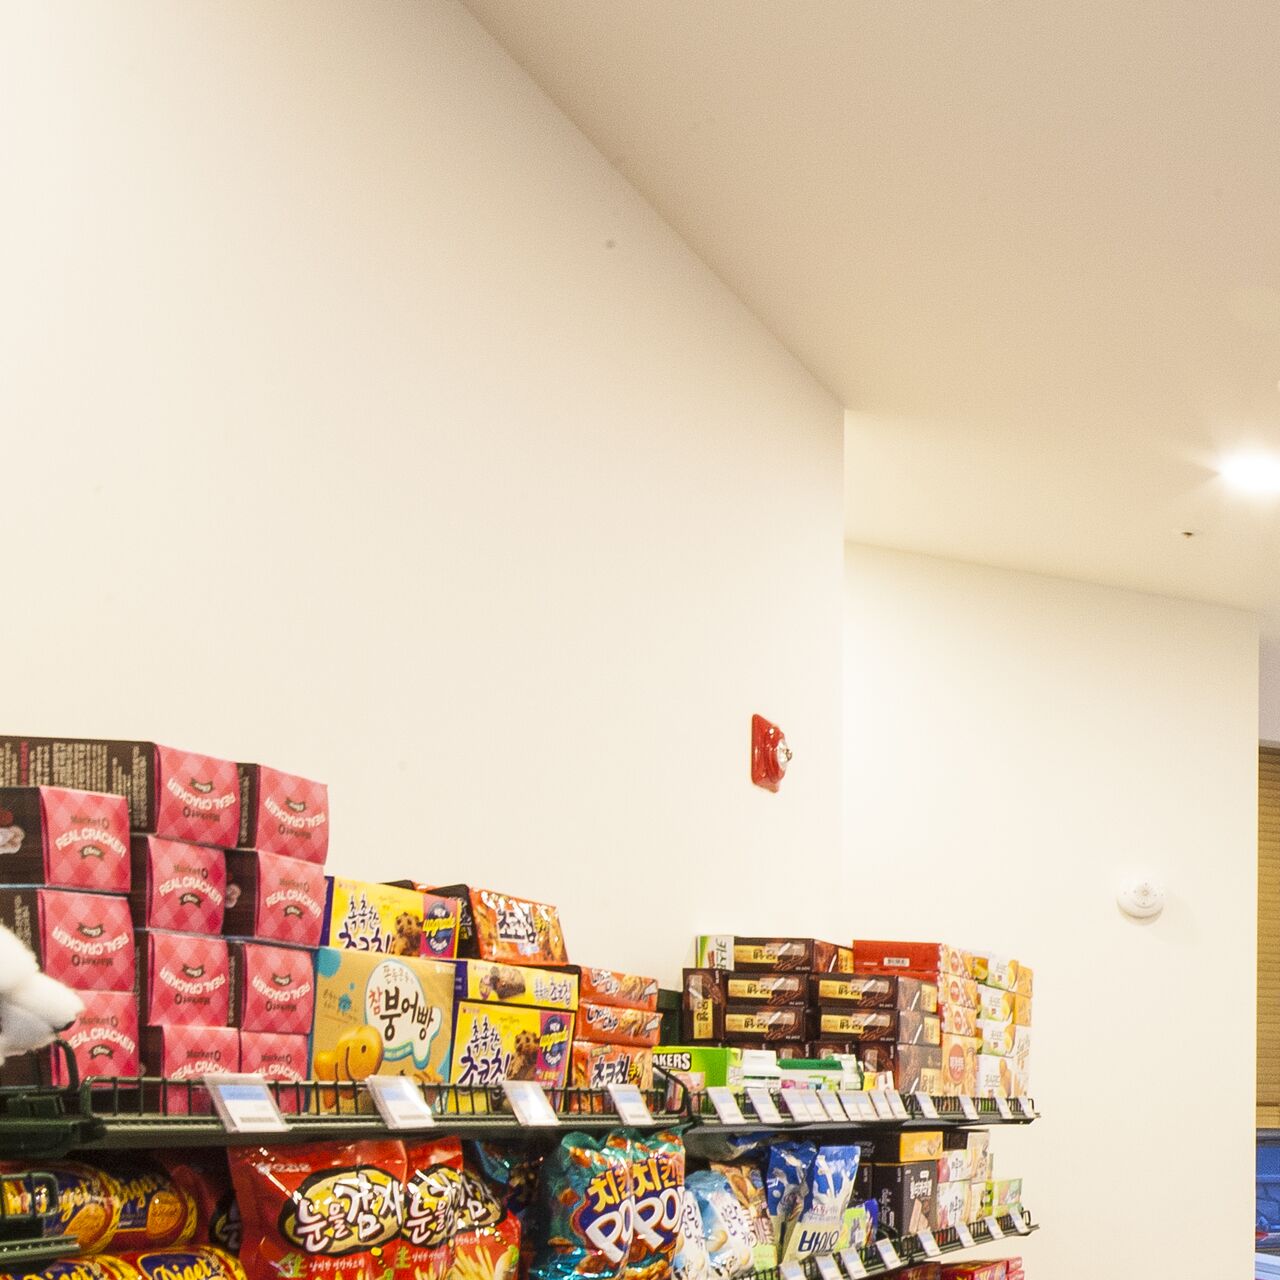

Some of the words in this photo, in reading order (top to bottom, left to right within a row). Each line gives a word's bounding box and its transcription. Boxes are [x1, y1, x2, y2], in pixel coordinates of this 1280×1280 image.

[167, 778, 212, 811] CRACKER
[208, 791, 236, 811] REAL
[265, 797, 304, 829] CRACKER
[55, 830, 80, 851] REAL
[82, 828, 127, 858] CRACKER
[159, 876, 182, 896] REAL
[183, 876, 223, 906] CRACKER
[266, 890, 287, 908] REAL
[287, 889, 322, 918] CRACKER
[52, 926, 103, 955] CRACKER
[104, 932, 129, 954] REAL
[160, 967, 203, 995] CRACKER
[252, 975, 290, 1002] CRACKER
[381, 986, 435, 1042] 붕어빵
[91, 1027, 136, 1055] CRACKER
